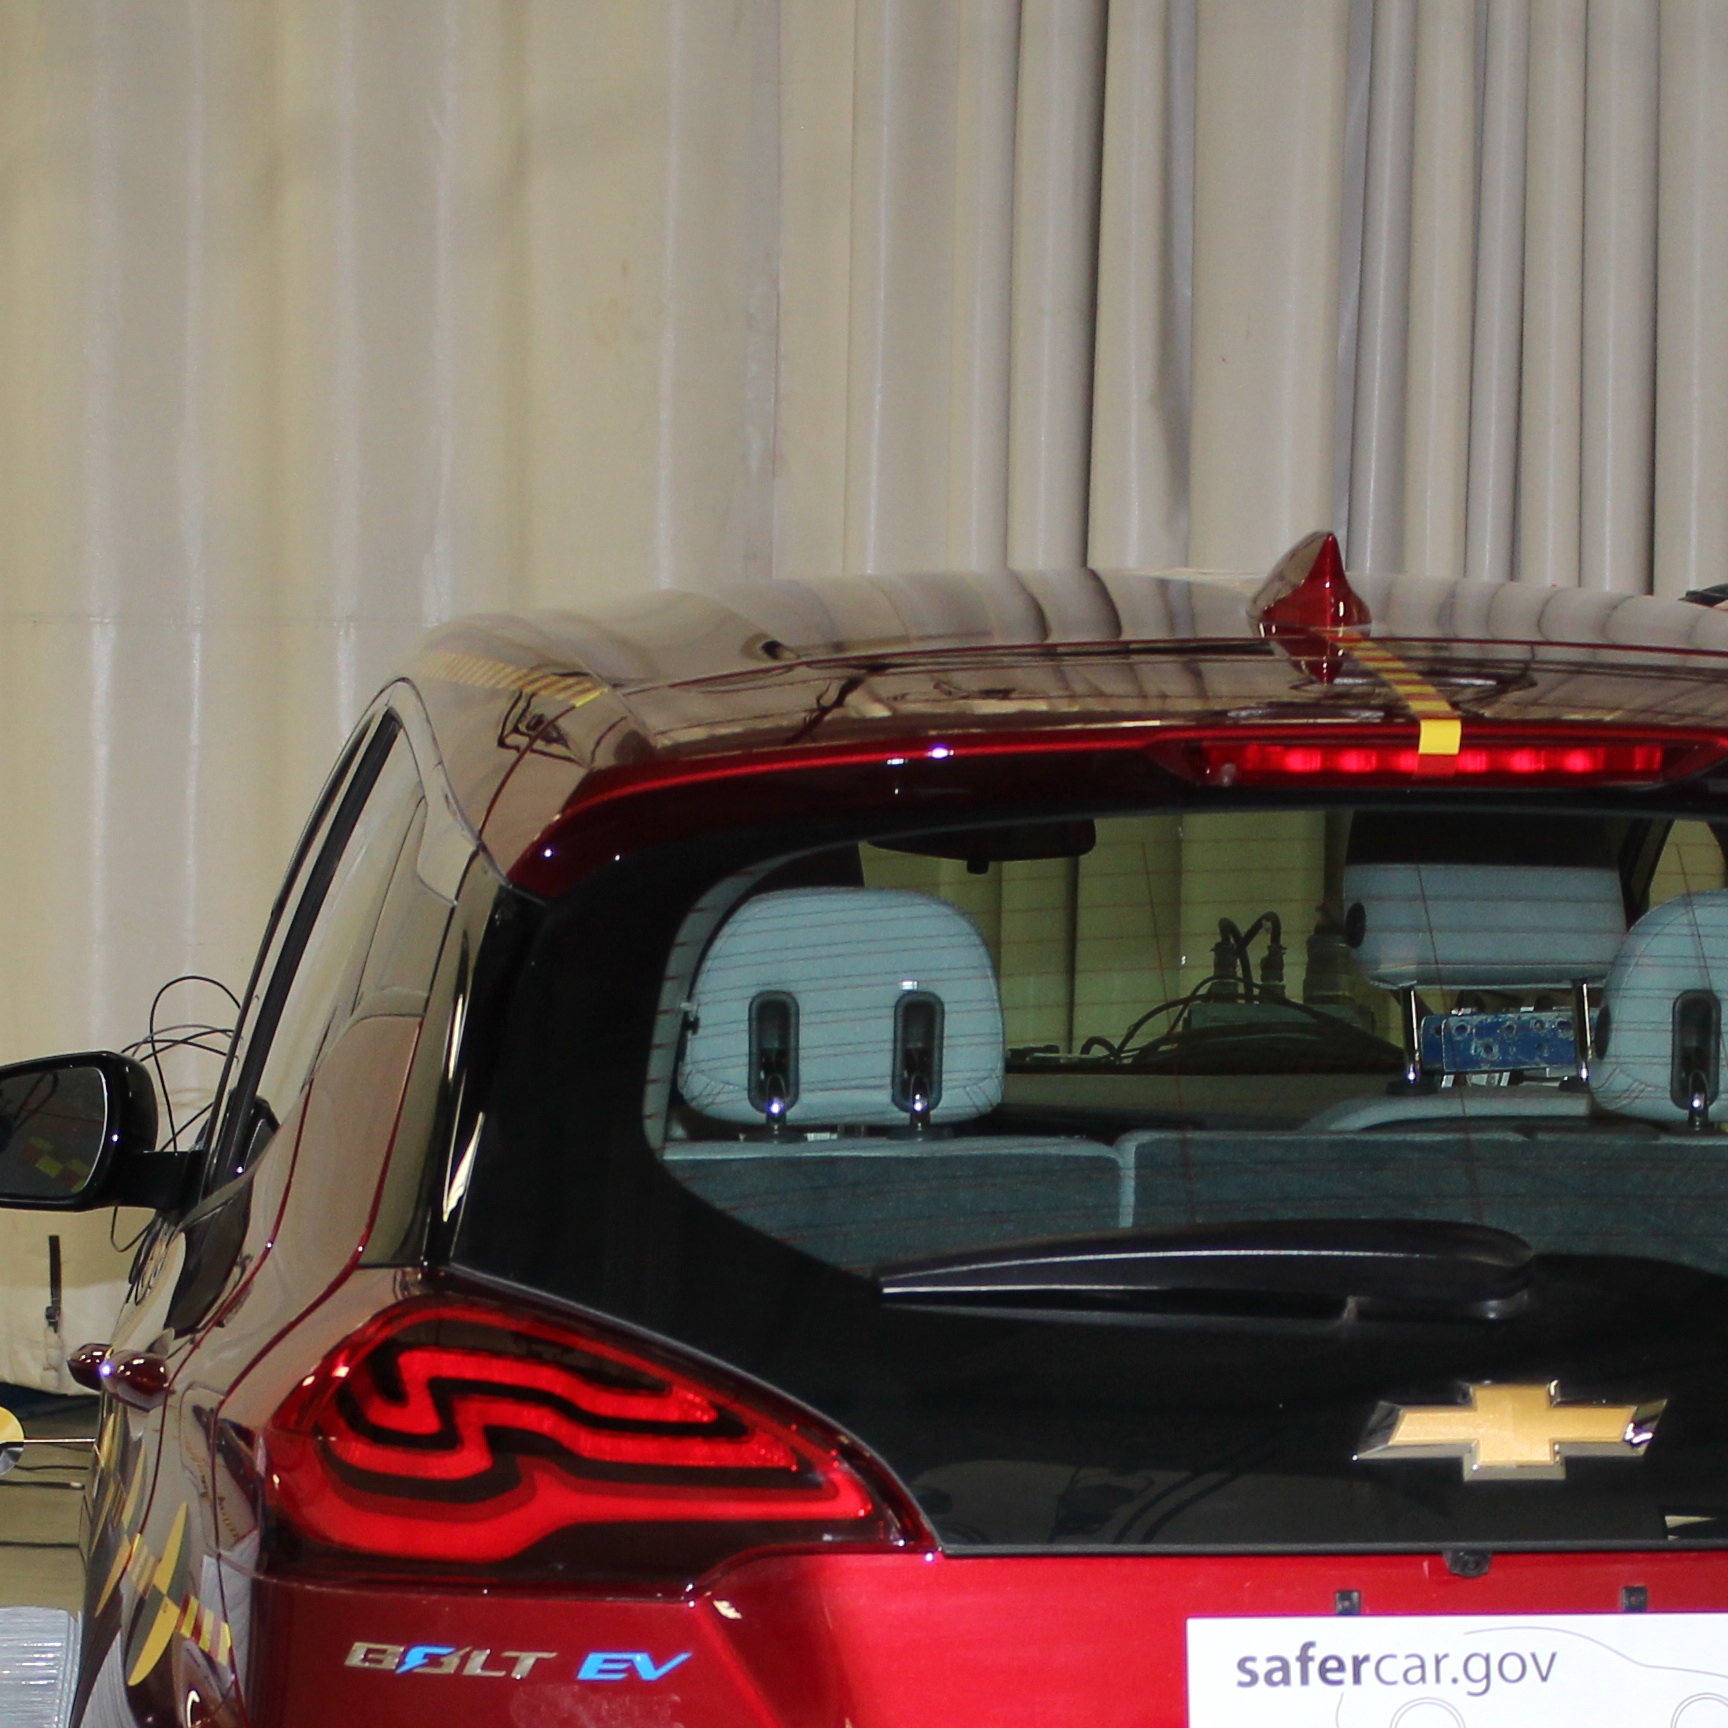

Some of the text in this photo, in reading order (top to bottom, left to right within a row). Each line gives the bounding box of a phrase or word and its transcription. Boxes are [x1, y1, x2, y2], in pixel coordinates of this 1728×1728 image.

[344, 1641, 694, 1682] BOLT EV
[1235, 1641, 1558, 1697] safercar.gov
